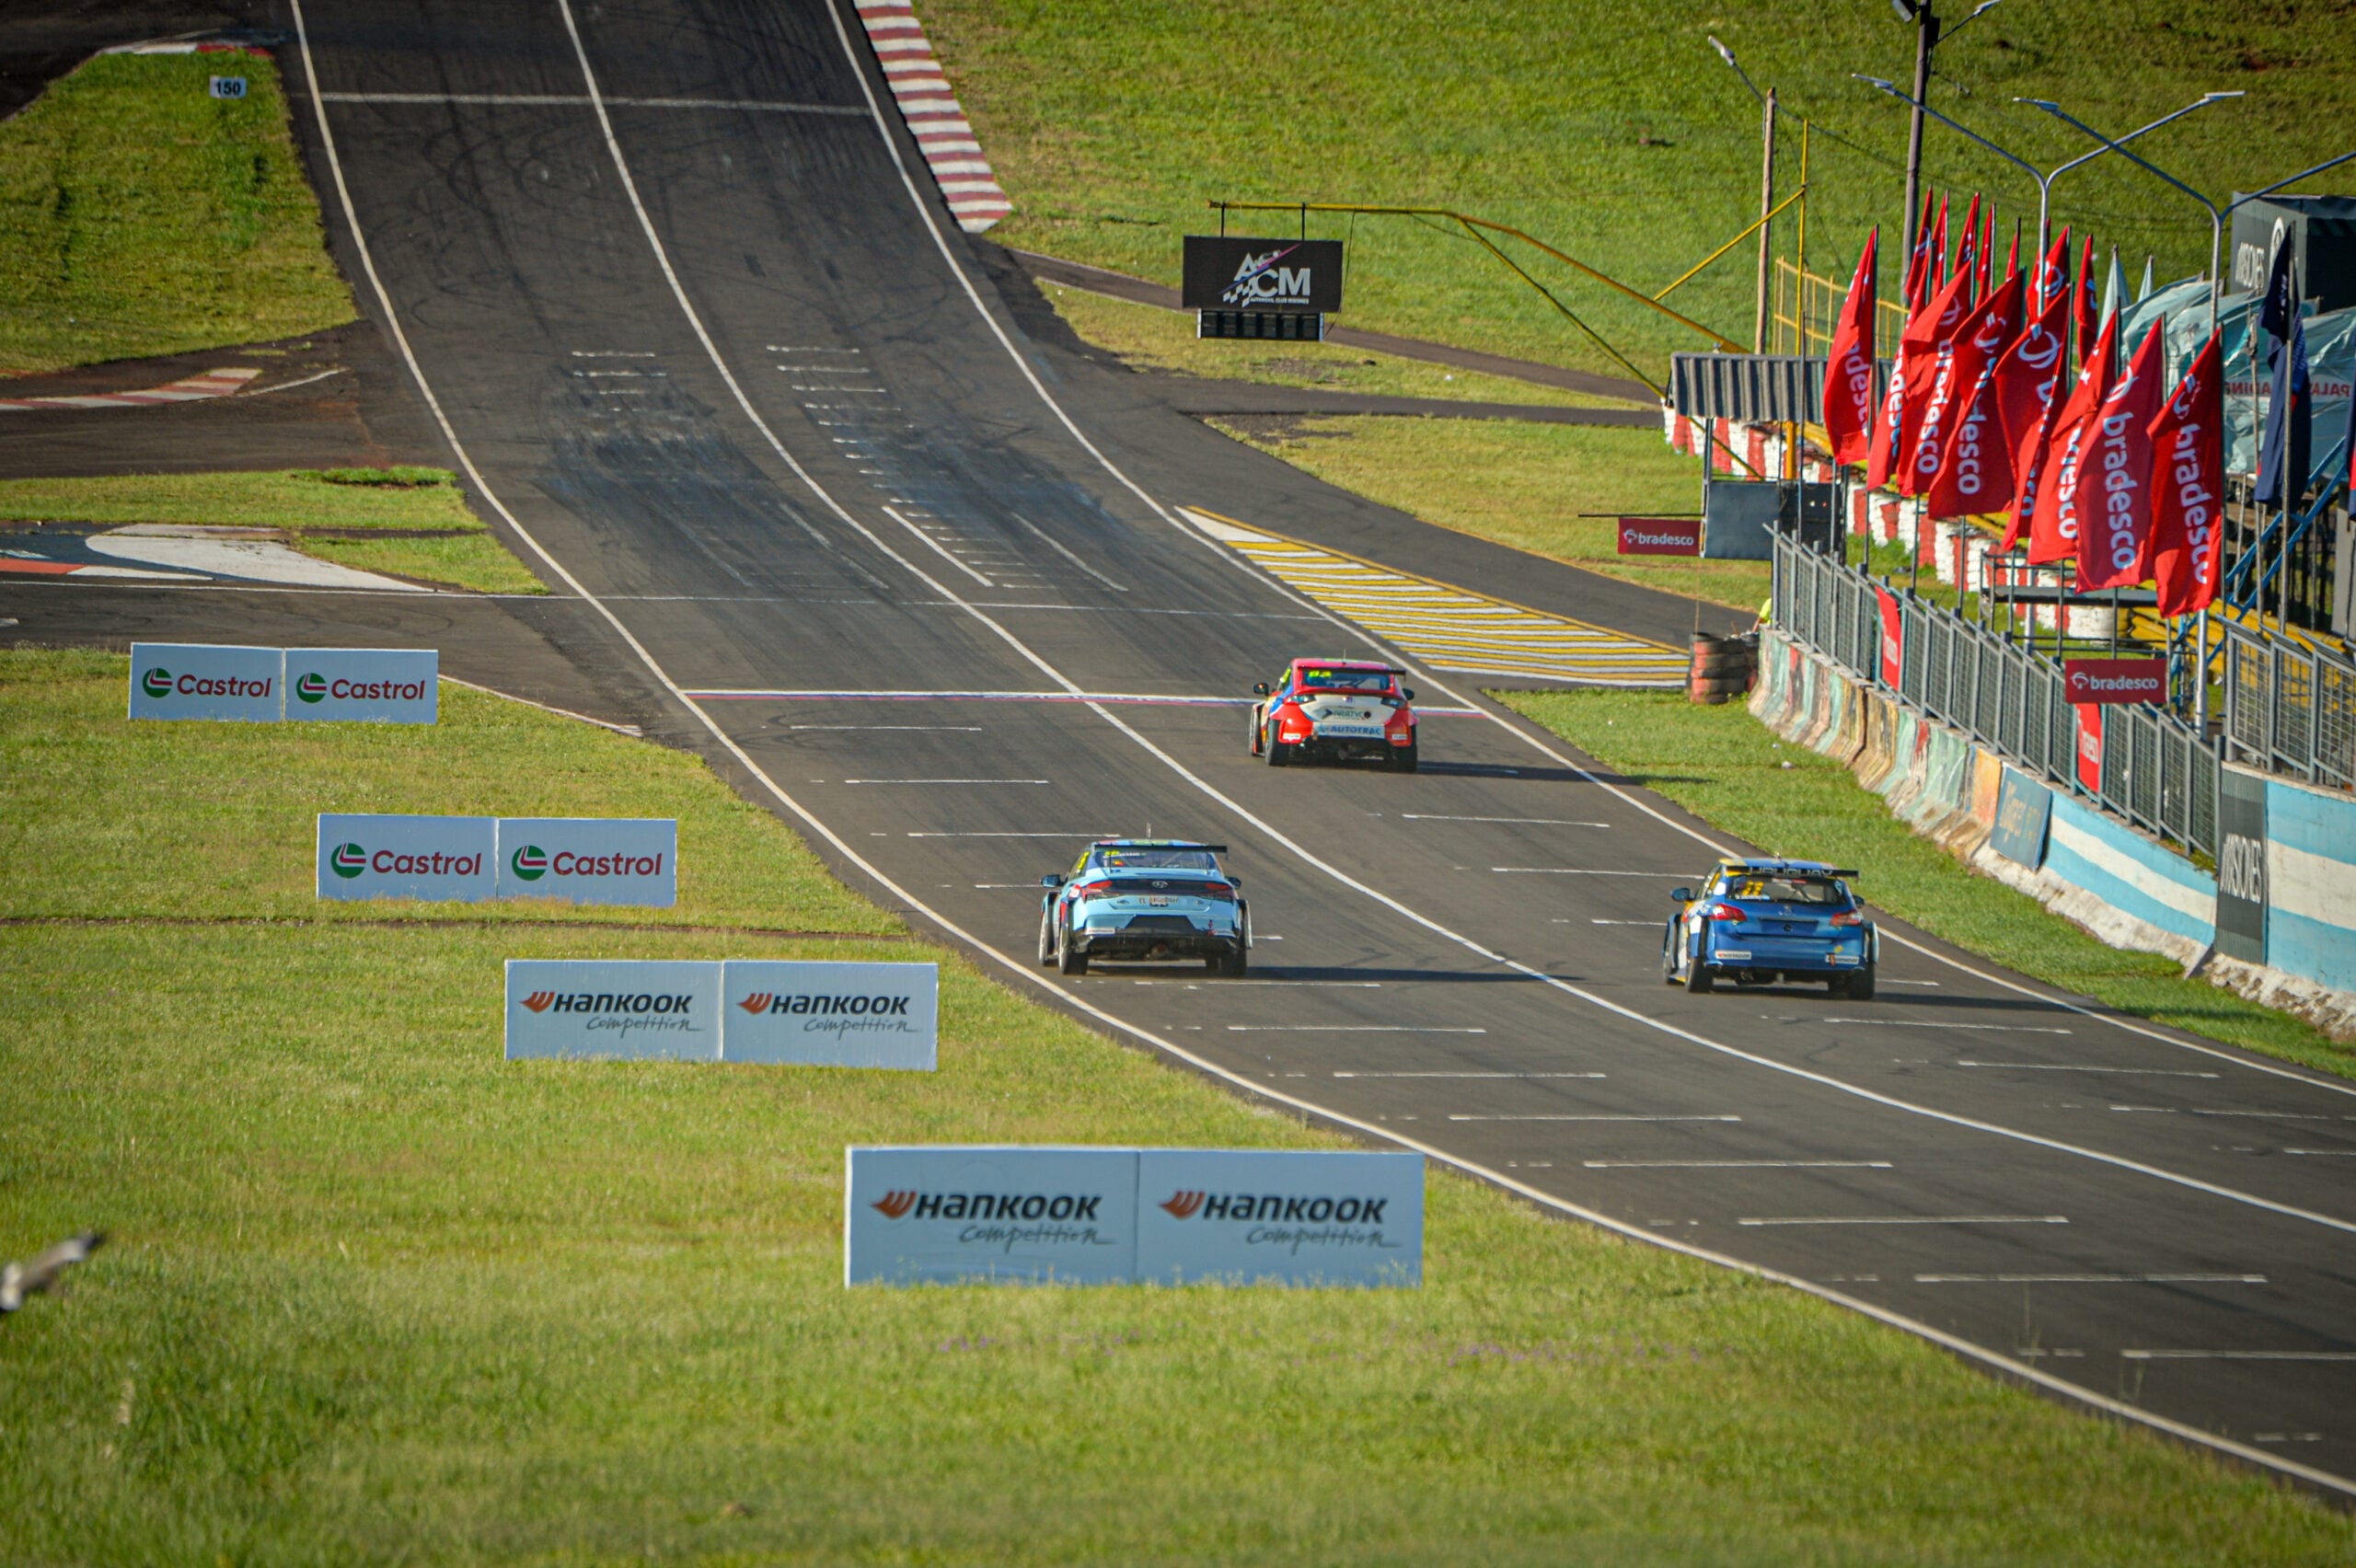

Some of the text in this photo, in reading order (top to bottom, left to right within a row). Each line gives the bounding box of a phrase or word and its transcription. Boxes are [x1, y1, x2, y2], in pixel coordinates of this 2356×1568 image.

[214, 80, 241, 97] 150
[1233, 252, 1311, 297] ACM
[2103, 411, 2138, 570] bradesco
[1638, 533, 1694, 546] bradesco
[177, 674, 271, 698] Castrol
[331, 678, 426, 701] Castrol
[2090, 674, 2159, 690] bradesco
[372, 849, 481, 876] Castrol
[552, 850, 663, 877] Castrol
[586, 1014, 705, 1039] Competition
[803, 1017, 919, 1041] Competition
[958, 1223, 1117, 1255] Competition
[1246, 1226, 1403, 1257] Competition
